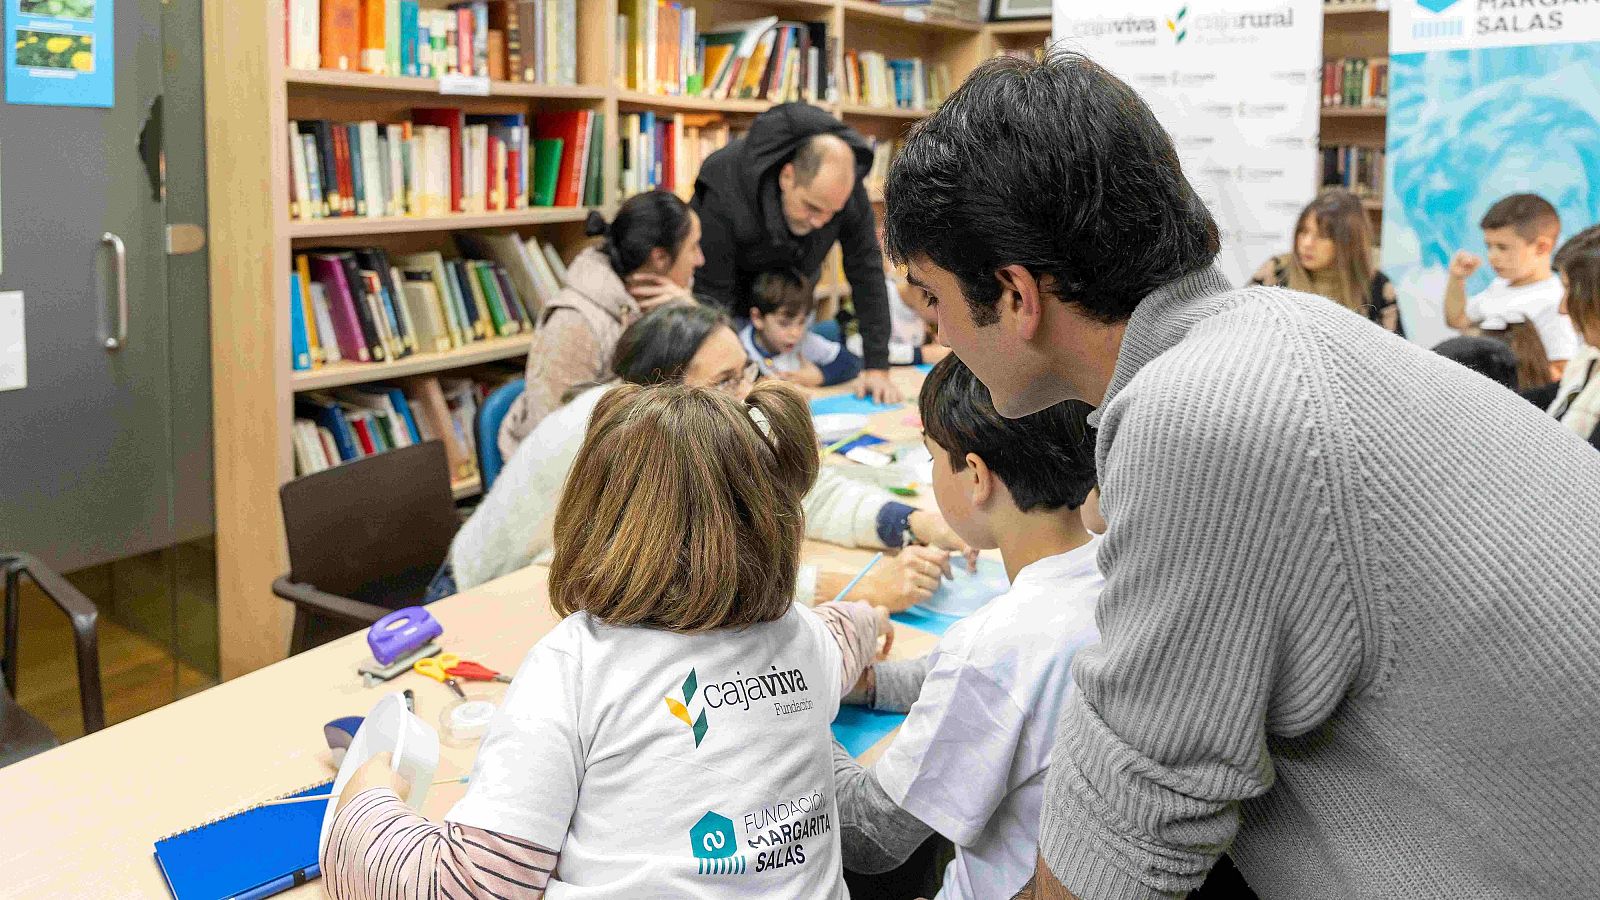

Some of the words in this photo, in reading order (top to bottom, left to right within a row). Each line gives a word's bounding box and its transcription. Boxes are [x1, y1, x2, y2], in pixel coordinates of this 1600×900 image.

[1476, 11, 1562, 35] SALAS
[704, 666, 808, 710] cajaviva
[774, 699, 813, 715] Fundación
[744, 790, 826, 834] FUNDACIÓN
[748, 813, 831, 849] MARGARITA
[756, 844, 805, 872] SALAS
